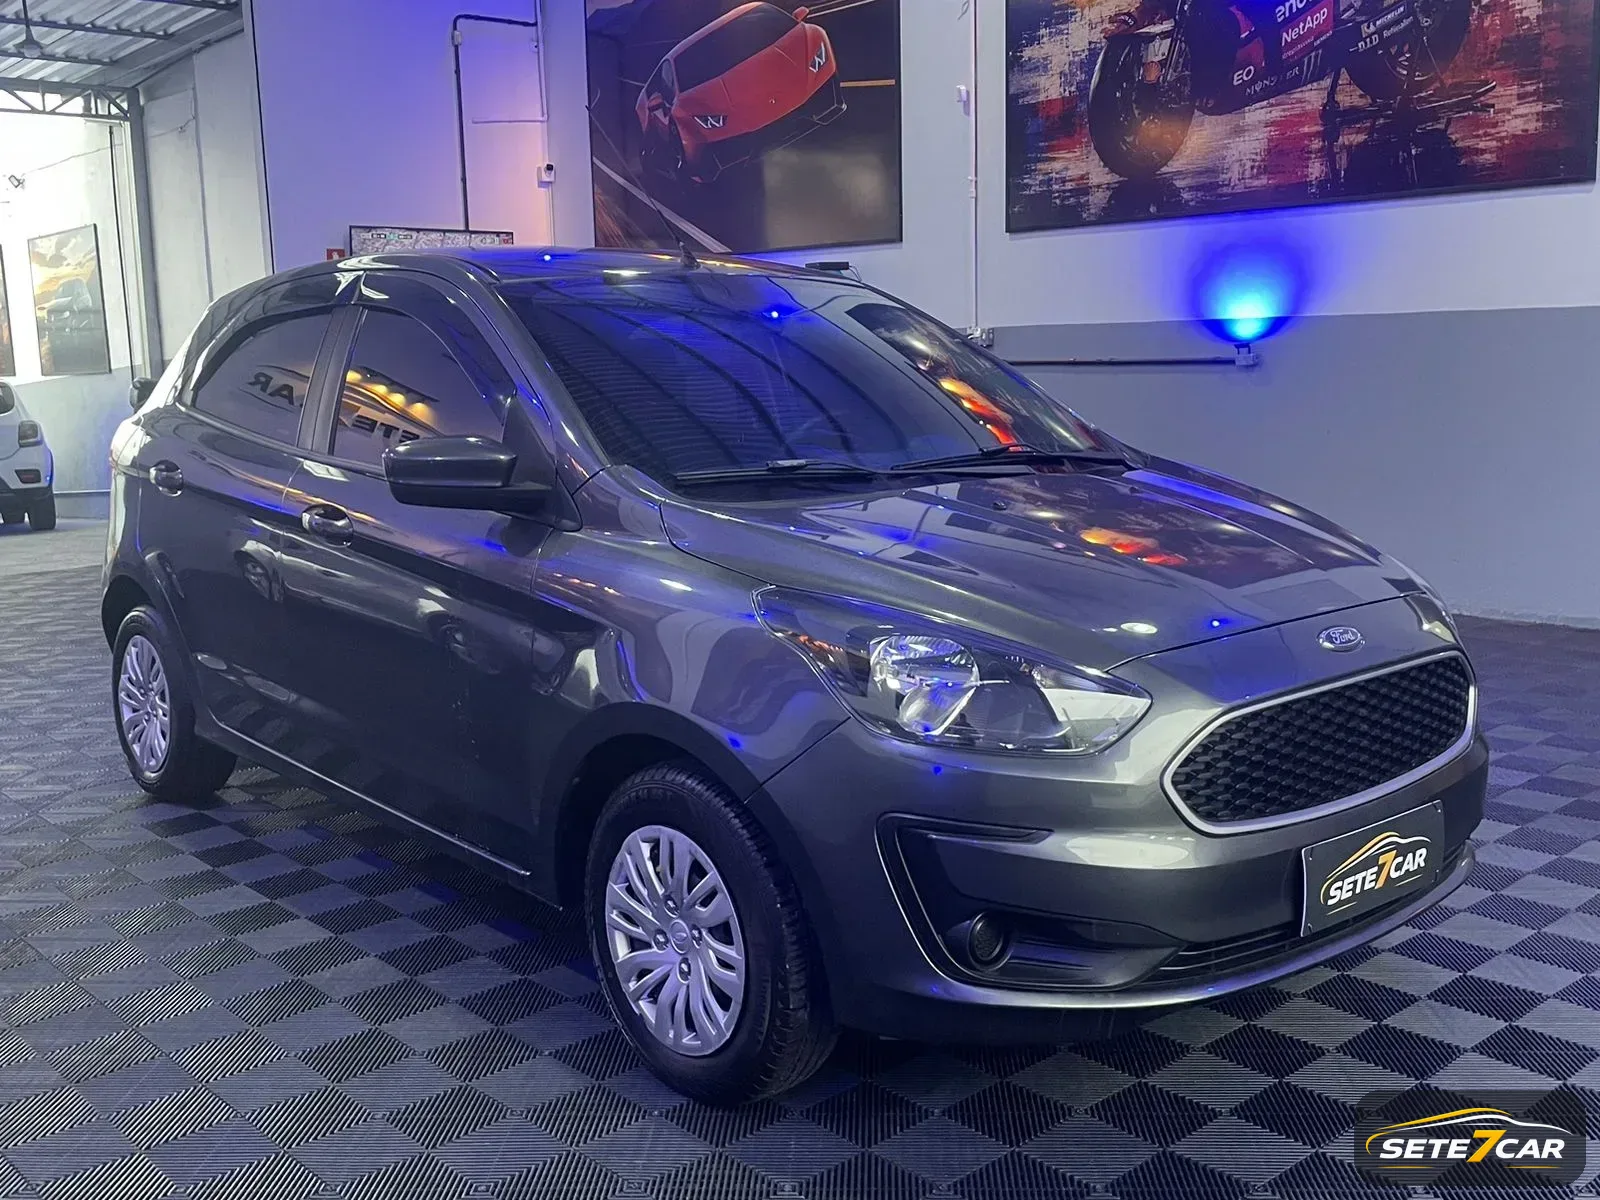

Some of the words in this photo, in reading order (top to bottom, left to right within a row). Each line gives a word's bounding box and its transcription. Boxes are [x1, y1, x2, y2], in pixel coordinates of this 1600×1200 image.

[1275, 0, 1313, 22] eno
[1281, 7, 1328, 46] NetApp
[1232, 65, 1256, 86] EO
[1245, 66, 1299, 96] MONSER
[1329, 629, 1356, 644] Ford
